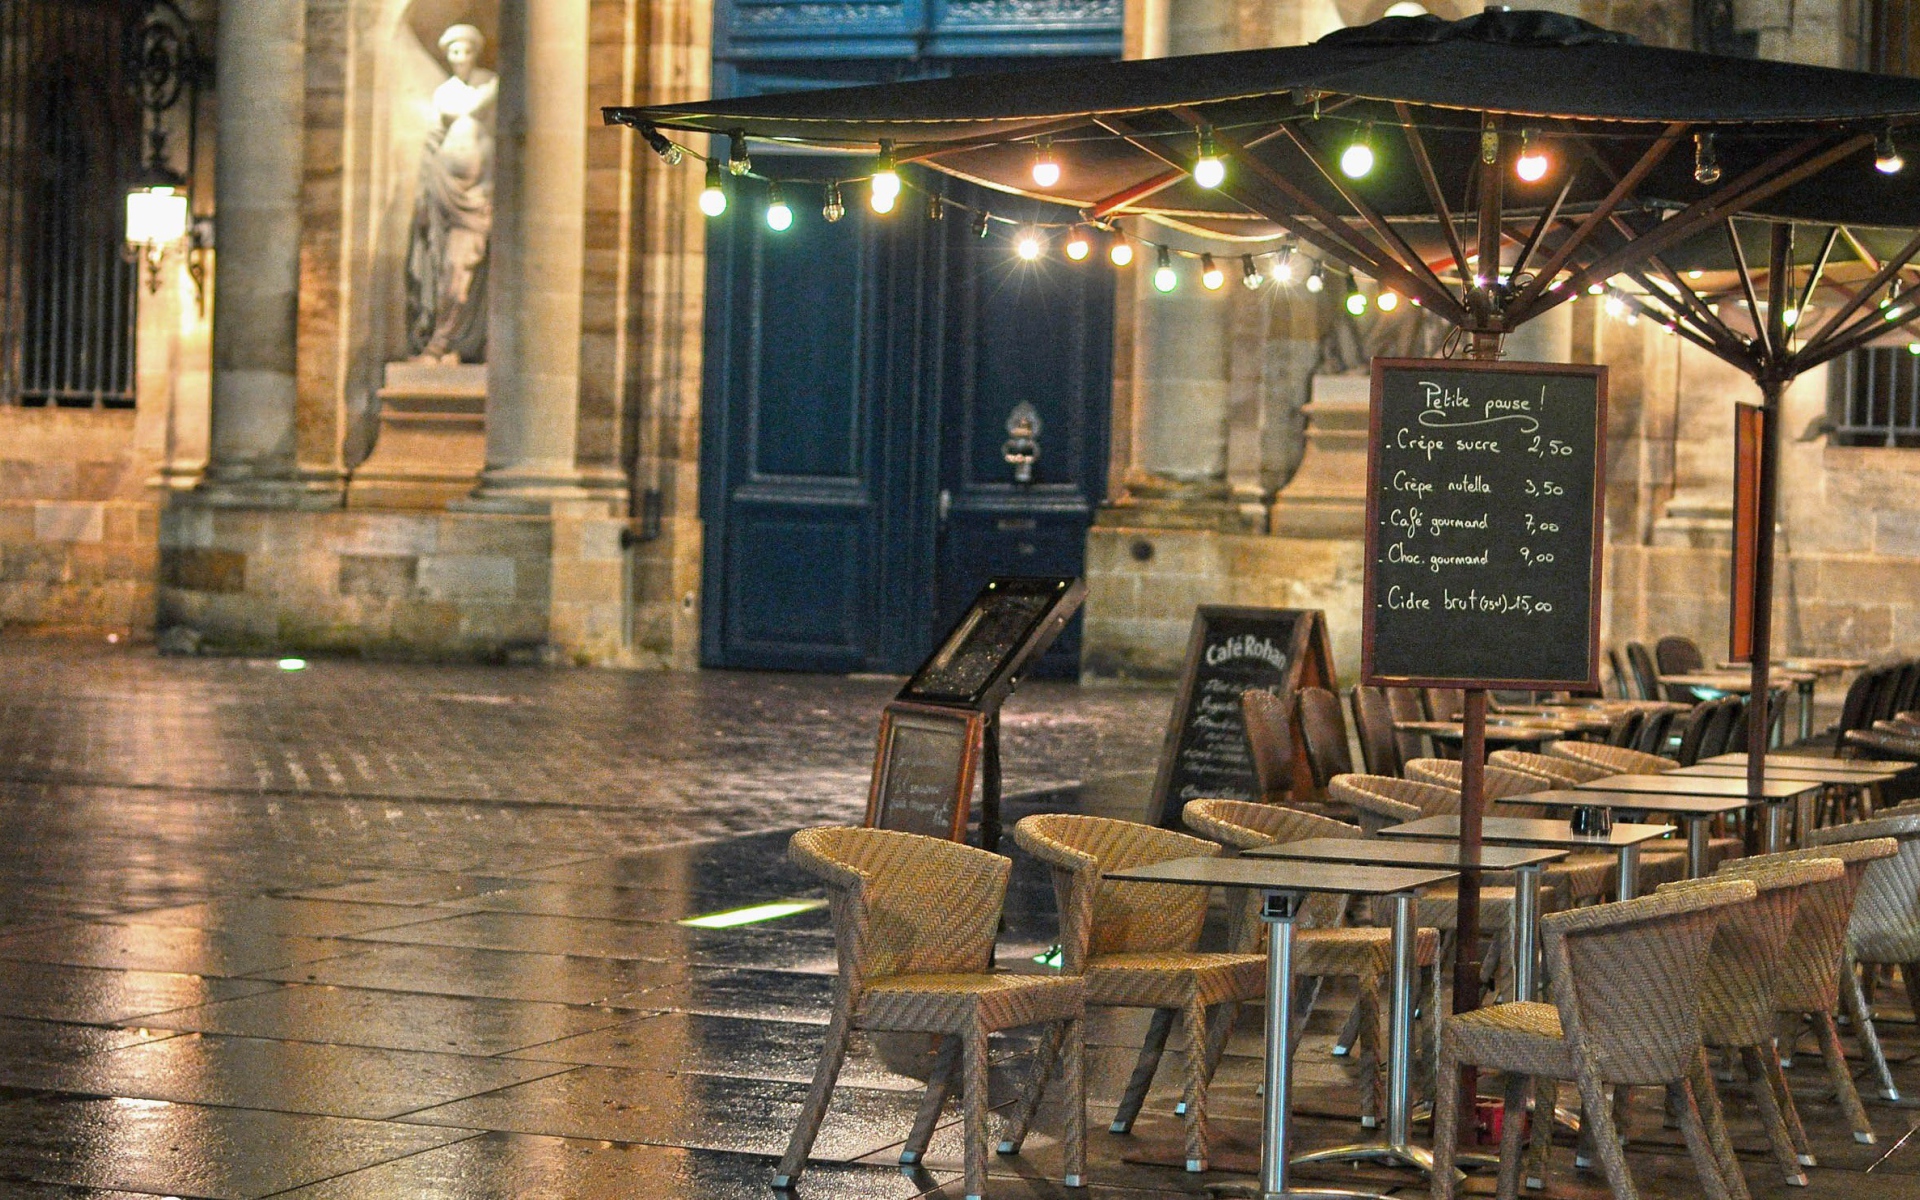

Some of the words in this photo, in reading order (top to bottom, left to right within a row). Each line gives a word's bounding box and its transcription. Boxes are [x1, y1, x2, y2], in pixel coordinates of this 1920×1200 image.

[1418, 381, 1470, 408] Petite
[1456, 439, 1500, 453] sucre
[1527, 435, 1573, 458] 2,50
[1448, 474, 1492, 493] nutella
[1524, 479, 1564, 497] 3,50
[1390, 507, 1424, 538] Café
[1430, 513, 1488, 536] gourmand
[1524, 513, 1560, 535] 7,00
[1388, 541, 1425, 564] Choc.
[1430, 549, 1489, 573] gourmand
[1519, 547, 1555, 566] 9,00
[1387, 585, 1431, 611] Cidre
[1508, 595, 1553, 615] 15,00
